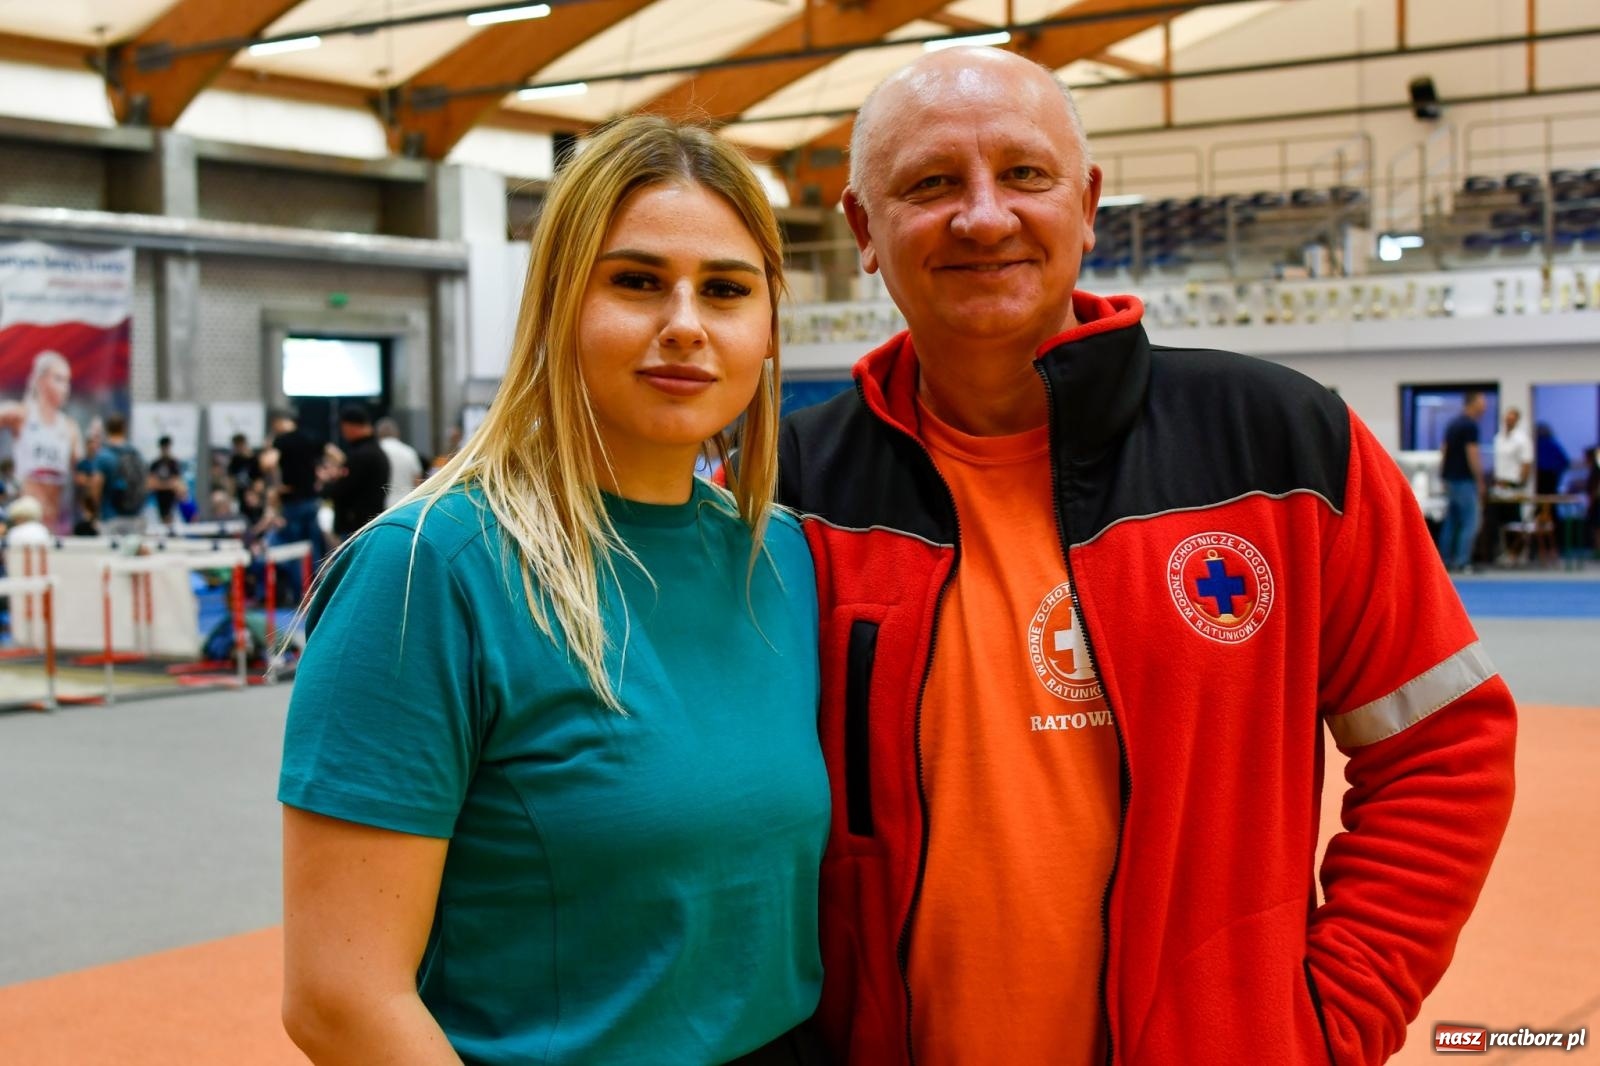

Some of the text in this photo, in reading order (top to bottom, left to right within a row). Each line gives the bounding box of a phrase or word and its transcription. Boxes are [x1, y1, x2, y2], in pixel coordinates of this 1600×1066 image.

[1171, 536, 1270, 618] WODNE OCHOTNICZE POGOTOWIE
[1030, 627, 1047, 678] WODNE
[1195, 618, 1259, 640] RATUNKOWE
